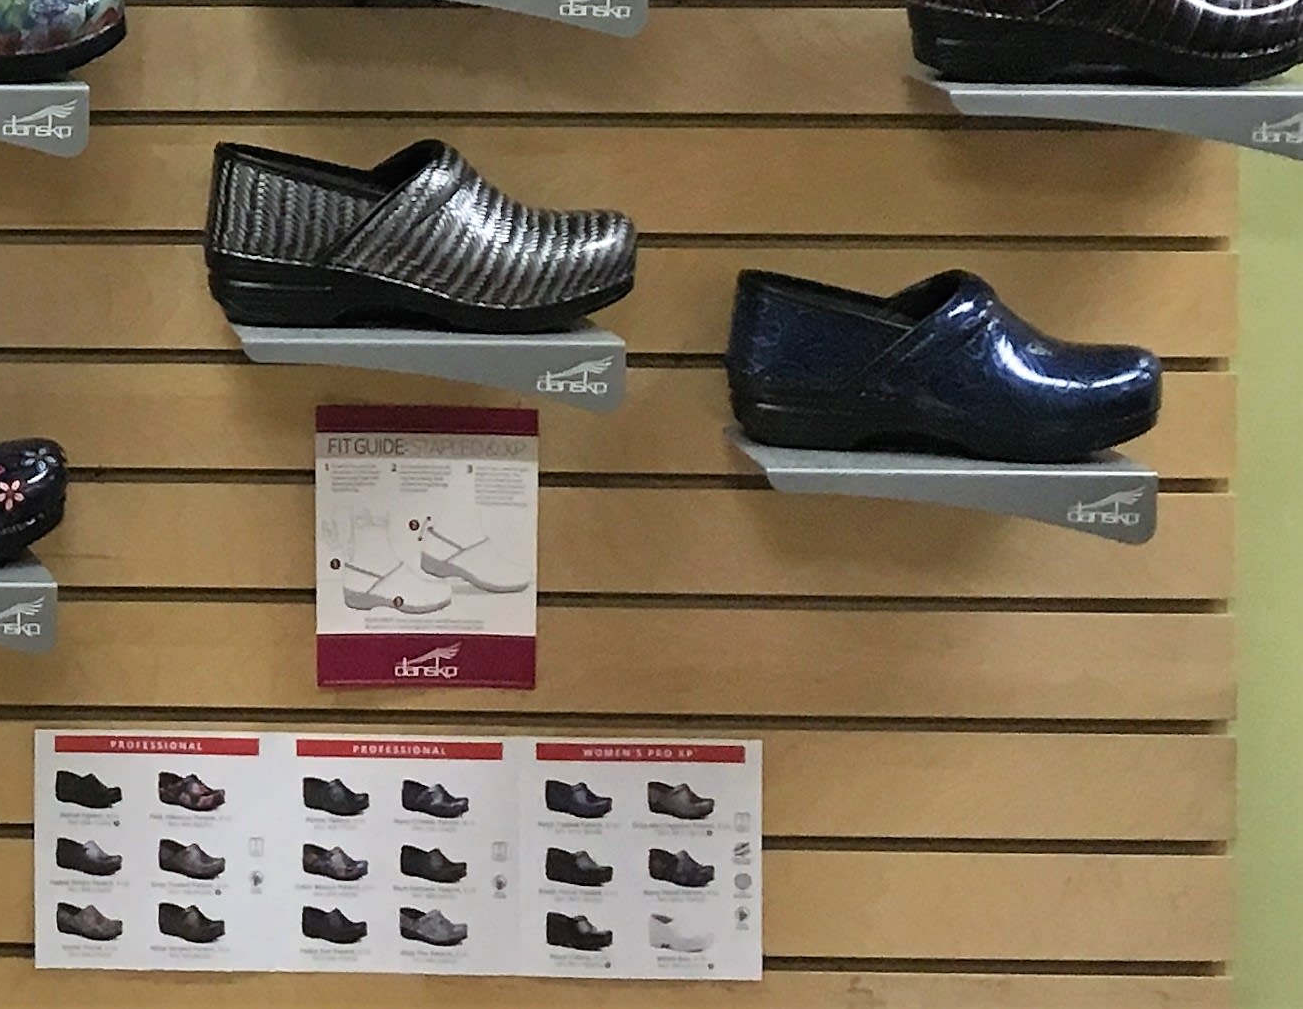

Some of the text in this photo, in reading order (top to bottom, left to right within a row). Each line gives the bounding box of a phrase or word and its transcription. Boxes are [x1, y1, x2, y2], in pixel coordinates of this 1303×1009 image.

[328, 438, 351, 455] FIT
[109, 740, 203, 751] PROFESSIONAL
[352, 744, 447, 755] PROFESSIONAL
[582, 748, 643, 758] WOMEN'S
[647, 749, 673, 758] PRO
